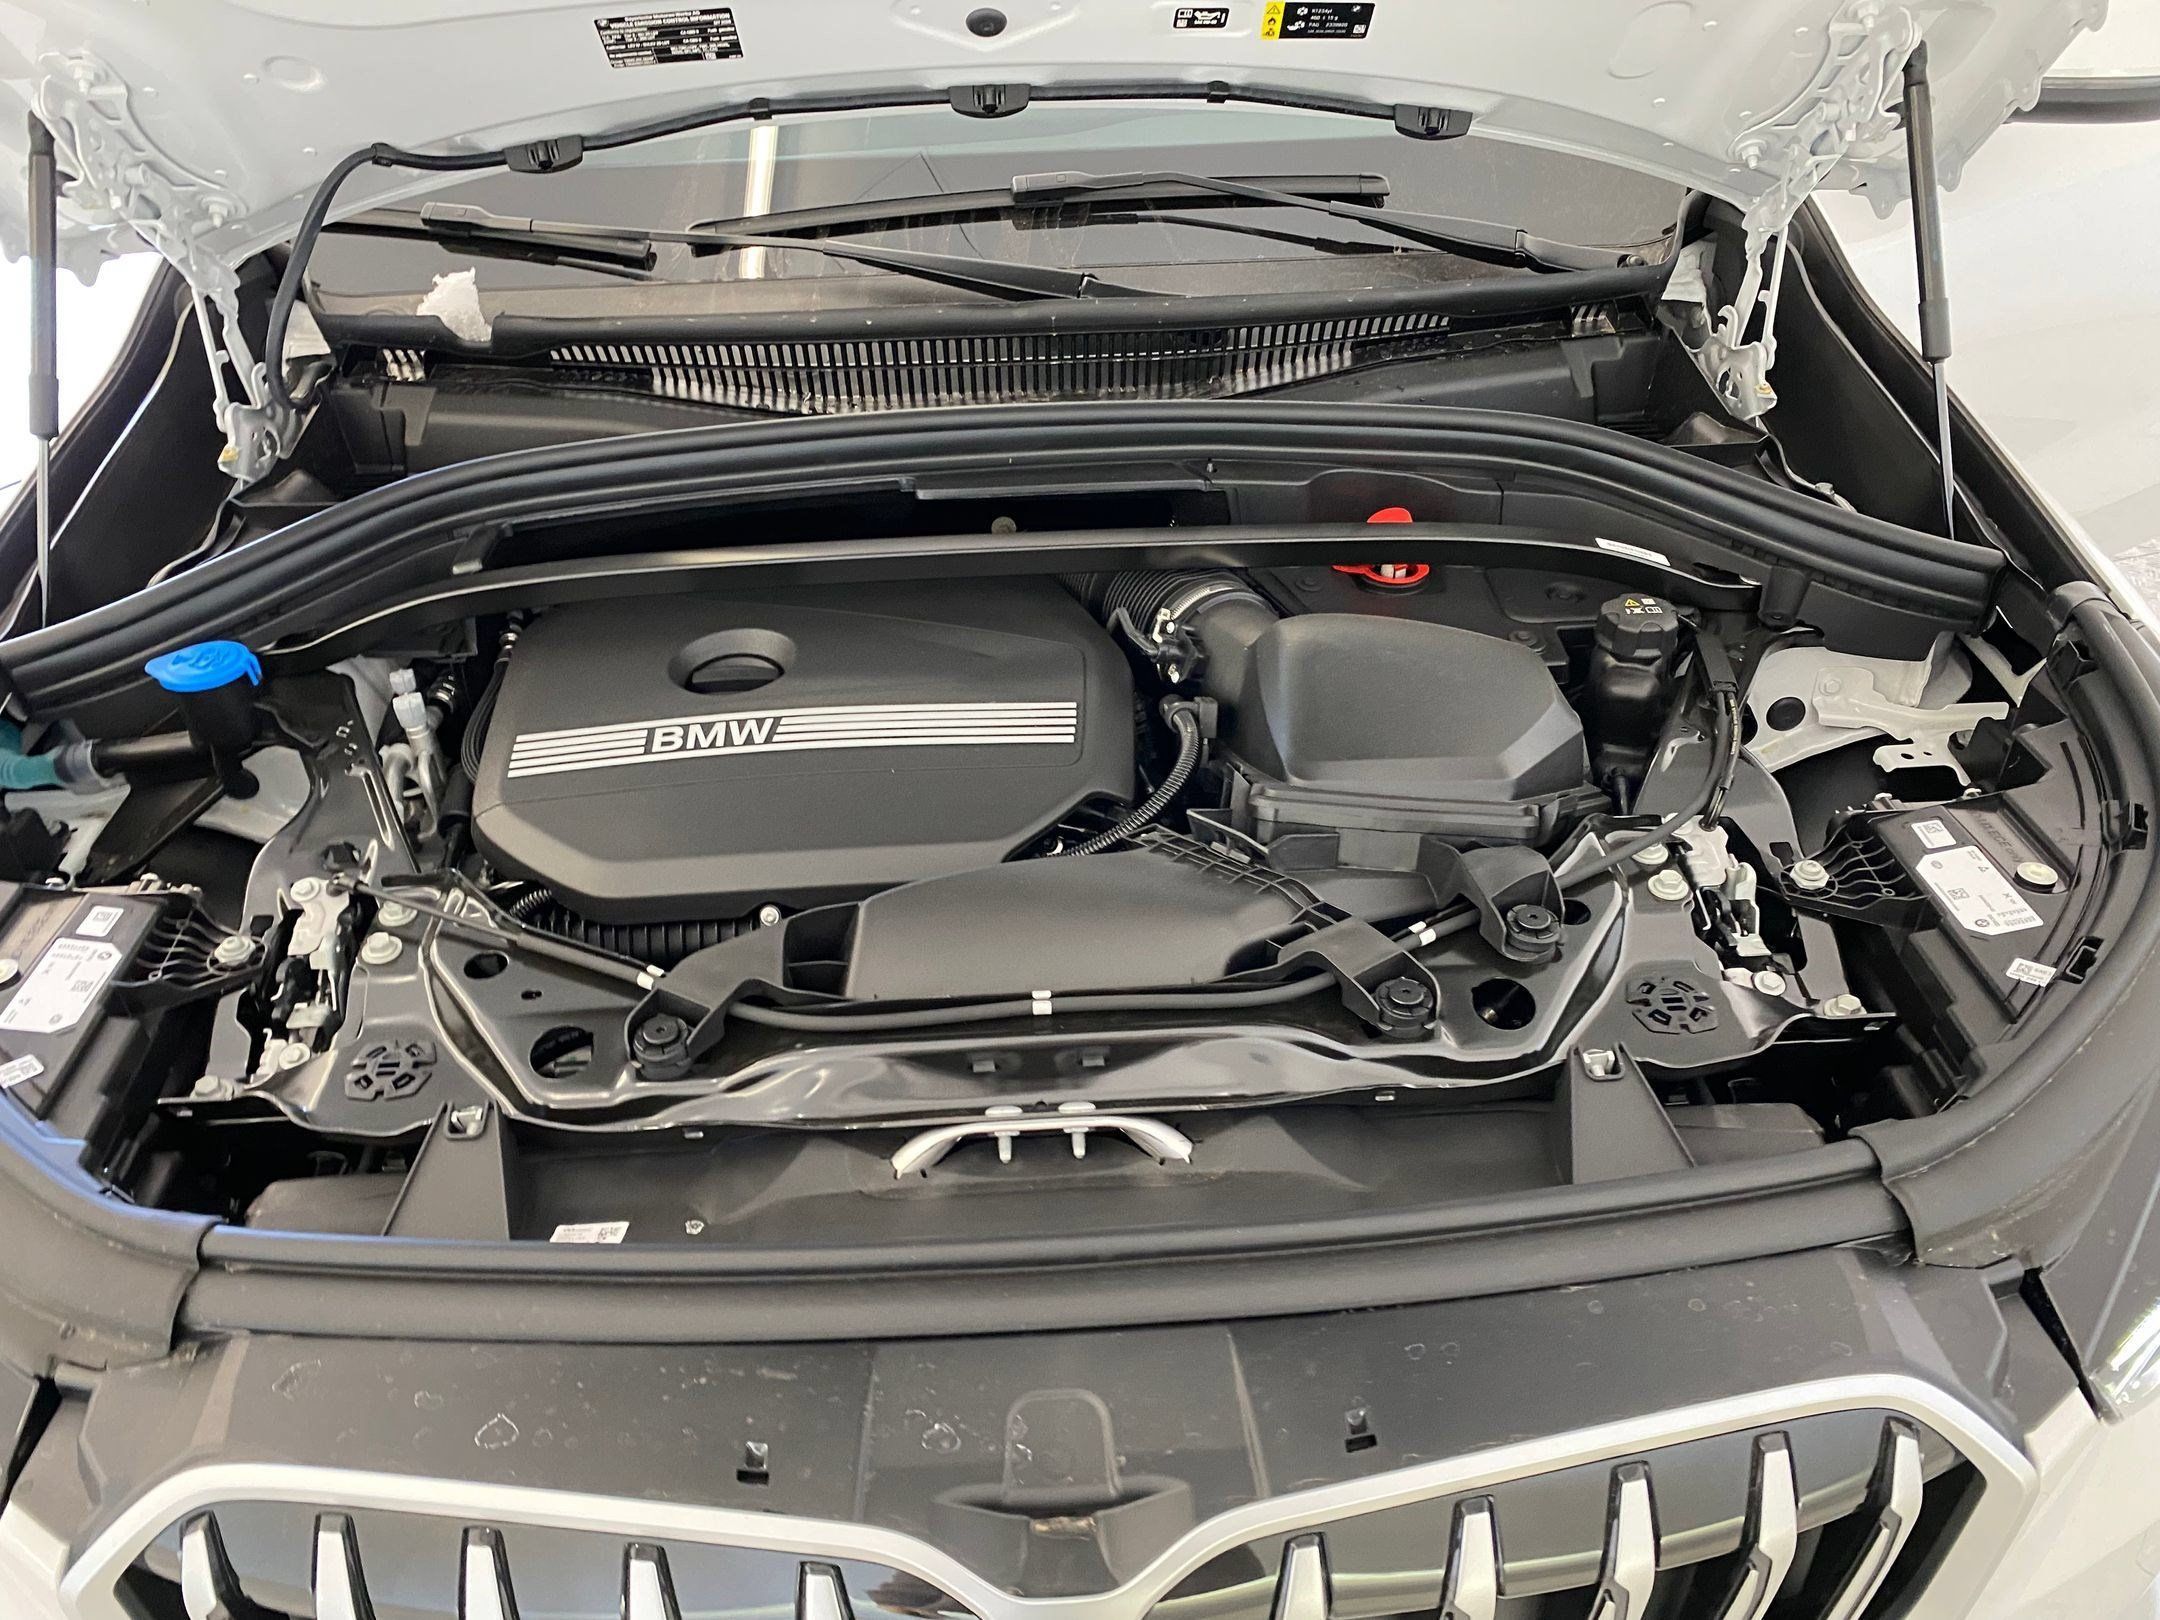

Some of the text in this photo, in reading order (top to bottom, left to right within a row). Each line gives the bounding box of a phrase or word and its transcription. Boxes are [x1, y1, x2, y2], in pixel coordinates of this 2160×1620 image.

[609, 20, 634, 30] VEHICLE
[634, 18, 662, 28] EMISSION
[662, 16, 690, 25] CONTROL
[689, 12, 731, 24] INFORMATION
[651, 717, 775, 754] BMW
